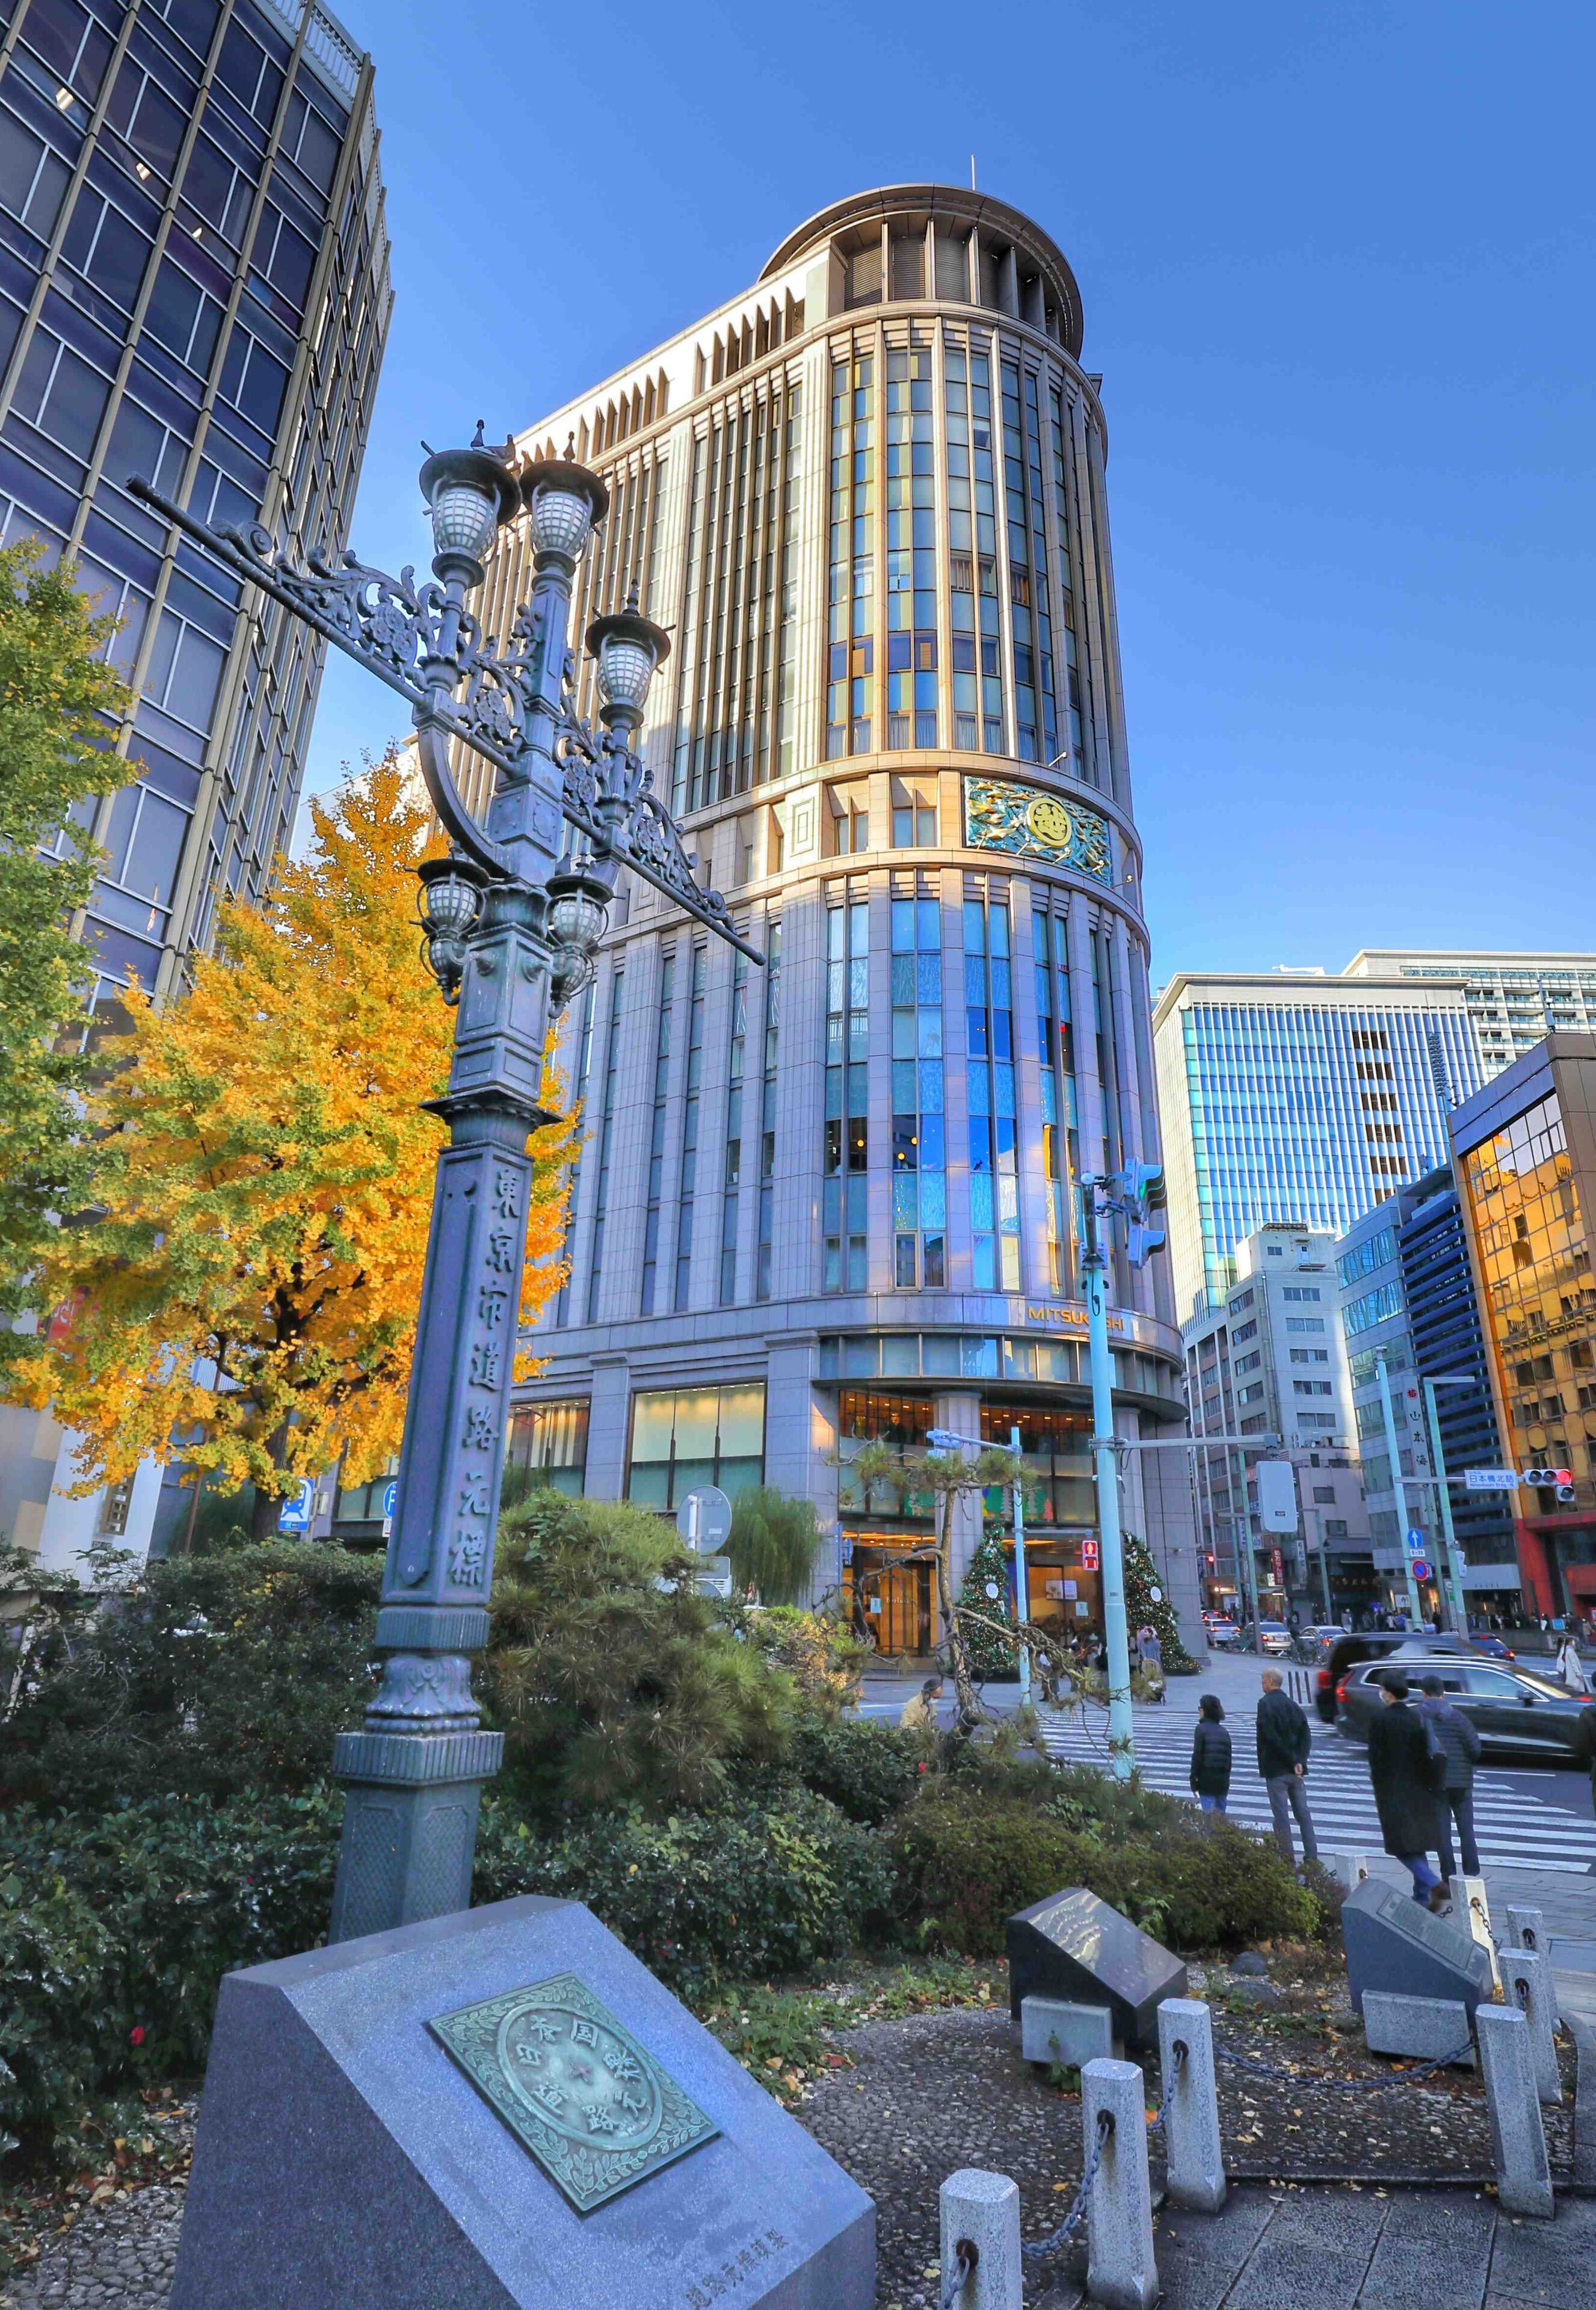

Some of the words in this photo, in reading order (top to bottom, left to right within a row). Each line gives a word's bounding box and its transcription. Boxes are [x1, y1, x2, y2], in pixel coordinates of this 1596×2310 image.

[449, 1168, 519, 1586] 東京市道路元標
[1028, 1307, 1124, 1331] MITSUKSHI
